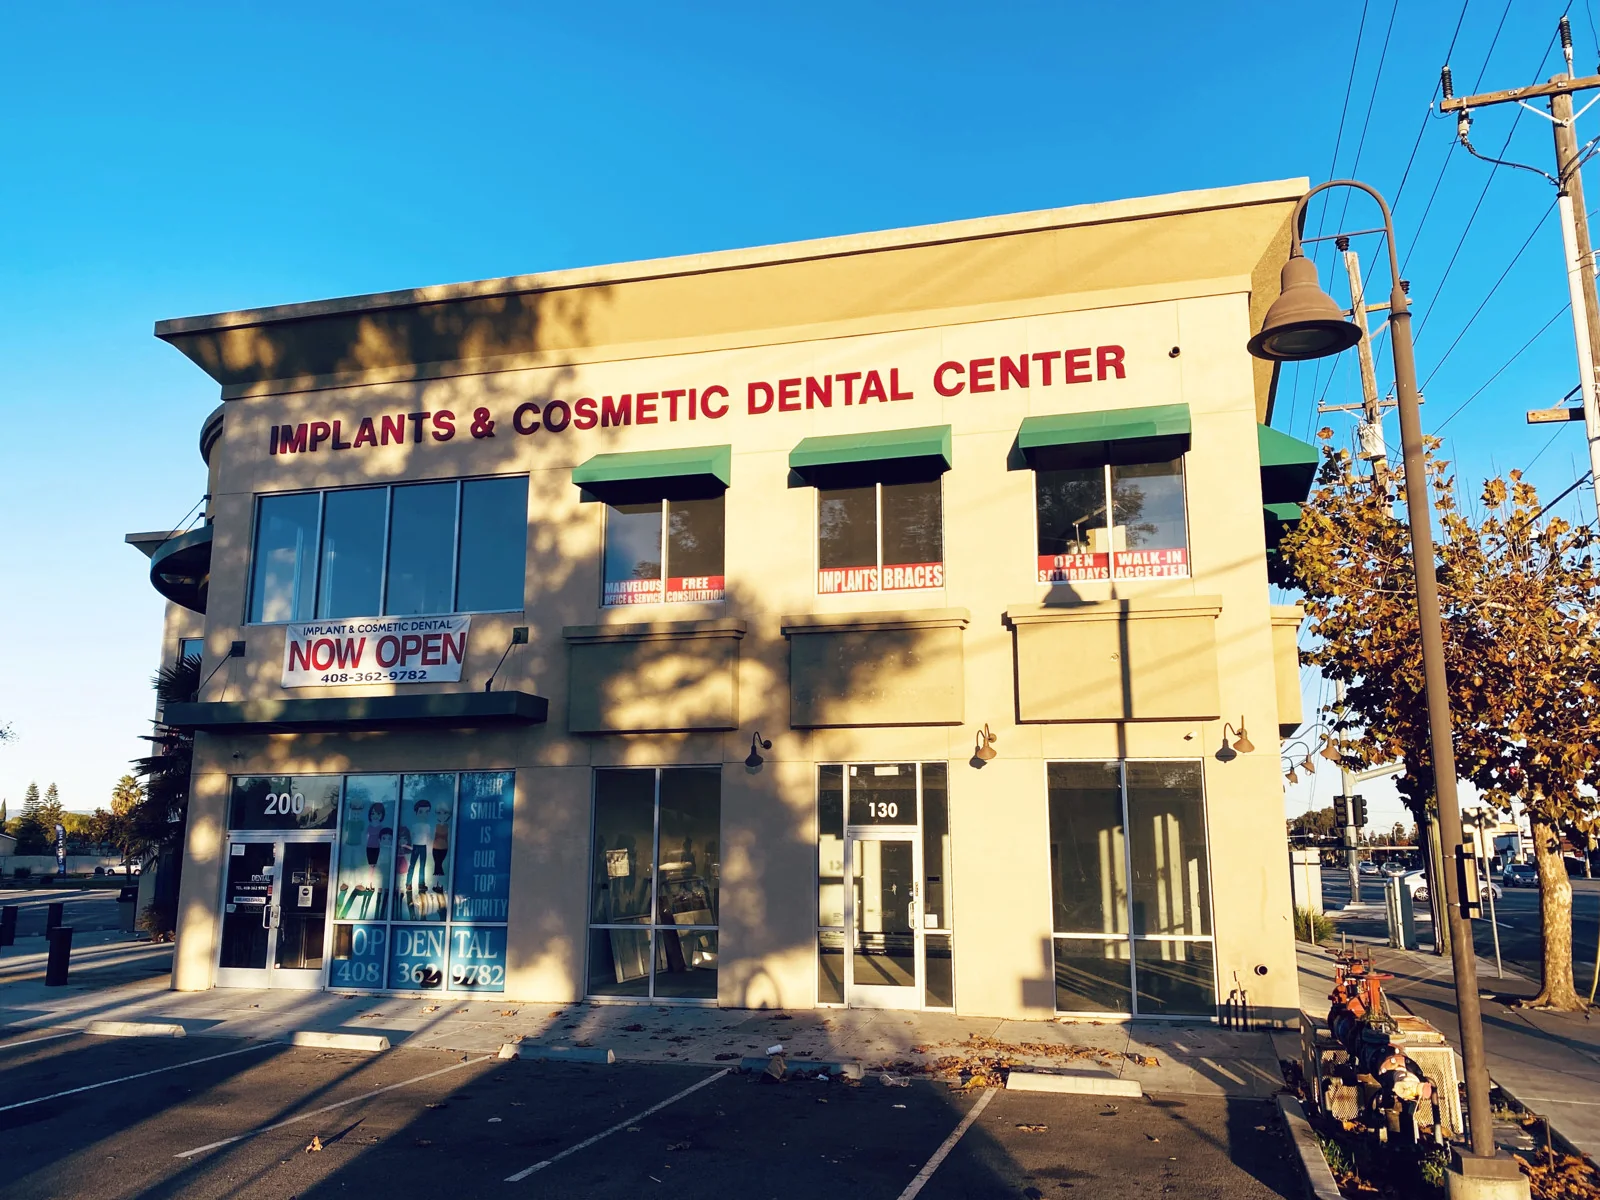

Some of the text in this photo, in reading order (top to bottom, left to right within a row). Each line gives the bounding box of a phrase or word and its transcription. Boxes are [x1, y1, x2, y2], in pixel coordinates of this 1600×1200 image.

[269, 345, 1126, 456] IMPLANTS & COSMETIC DENTAL CENTER
[1053, 553, 1094, 568] OPEN
[1117, 551, 1182, 566] WALK-IN
[883, 565, 943, 589] BRACES
[1039, 567, 1108, 582] SATURDAYS
[1115, 564, 1187, 579] ACCEPTED
[604, 580, 662, 594] MARVELOUS
[682, 577, 709, 590] FREE
[819, 568, 878, 593] IMPLANTS
[604, 593, 626, 605] OFFICE
[666, 589, 725, 603] CONSULTATION
[303, 620, 453, 636] IMPLANT & COSMETIC DENTAL
[288, 632, 466, 672] NOW OPEN
[321, 670, 427, 683] 408-362-9782
[264, 792, 305, 815] 200
[470, 801, 504, 820] SMILE
[868, 802, 898, 818] 130
[480, 826, 491, 843] IS
[473, 850, 495, 868] OUR
[473, 874, 494, 892] TOP
[456, 898, 508, 917] PRIORITY
[337, 962, 504, 985] 408 362 9782
